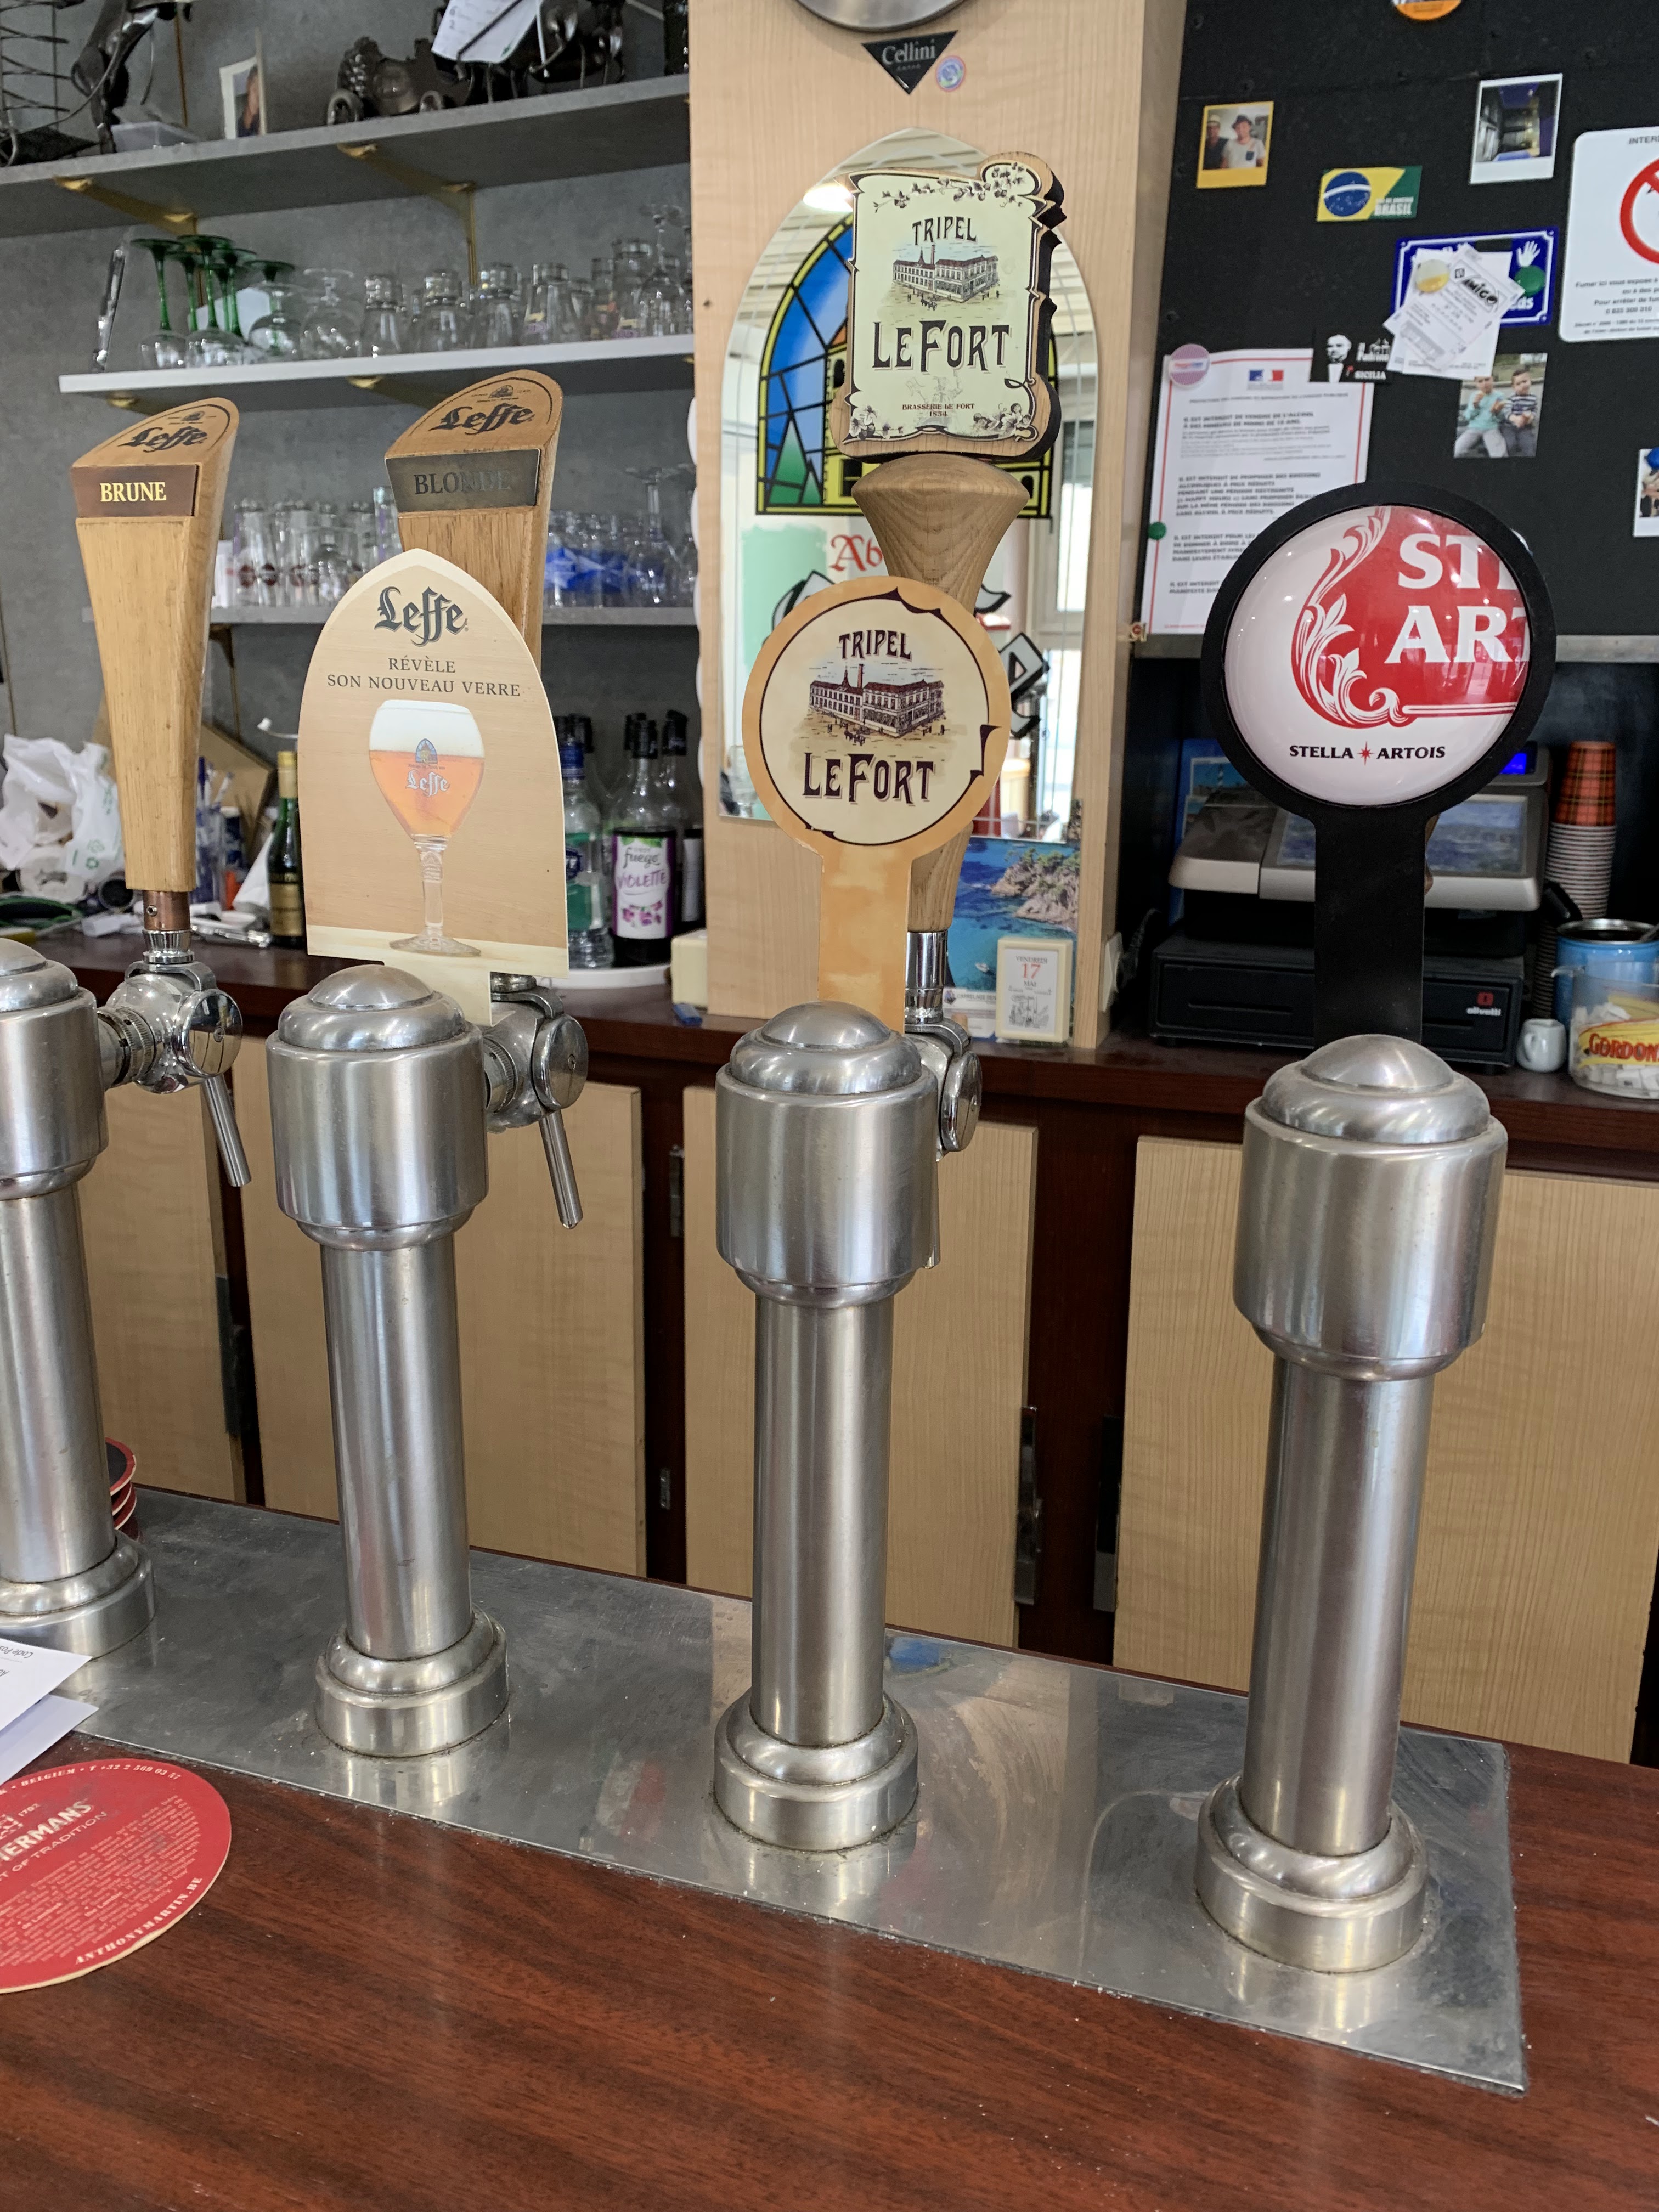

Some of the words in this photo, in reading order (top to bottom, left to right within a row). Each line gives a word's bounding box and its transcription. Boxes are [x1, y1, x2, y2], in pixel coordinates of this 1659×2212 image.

[881, 39, 935, 65] Cellini
[1629, 136, 1659, 144] INTER
[1374, 203, 1412, 216] BRASIL
[912, 216, 977, 245] TRIPEL
[428, 402, 535, 436] Leffe
[117, 426, 208, 453] Leffe
[99, 481, 167, 502] BRUNE
[374, 586, 469, 647] Leffe
[839, 630, 912, 660] TRIPEL
[388, 655, 456, 674] RÉVÈLE
[328, 674, 361, 688] SON
[369, 676, 454, 693] NOUVEAU
[462, 681, 521, 697] VERRE
[1290, 745, 1354, 759] STELLA
[1376, 746, 1446, 759] ARTOIS
[405, 769, 450, 797] Leffe
[1016, 955, 1048, 964] VENDREDI
[1022, 963, 1041, 979] 17
[1466, 1006, 1502, 1017] olivetti
[12, 1649, 33, 1658] Code
[21, 1768, 75, 1787] BELGIUM
[18, 1803, 41, 1818] 1702
[12, 1859, 31, 1872] OF
[30, 1810, 108, 1860] TRADITION
[75, 1877, 202, 1965] ANTHONYMARTIN.BE
